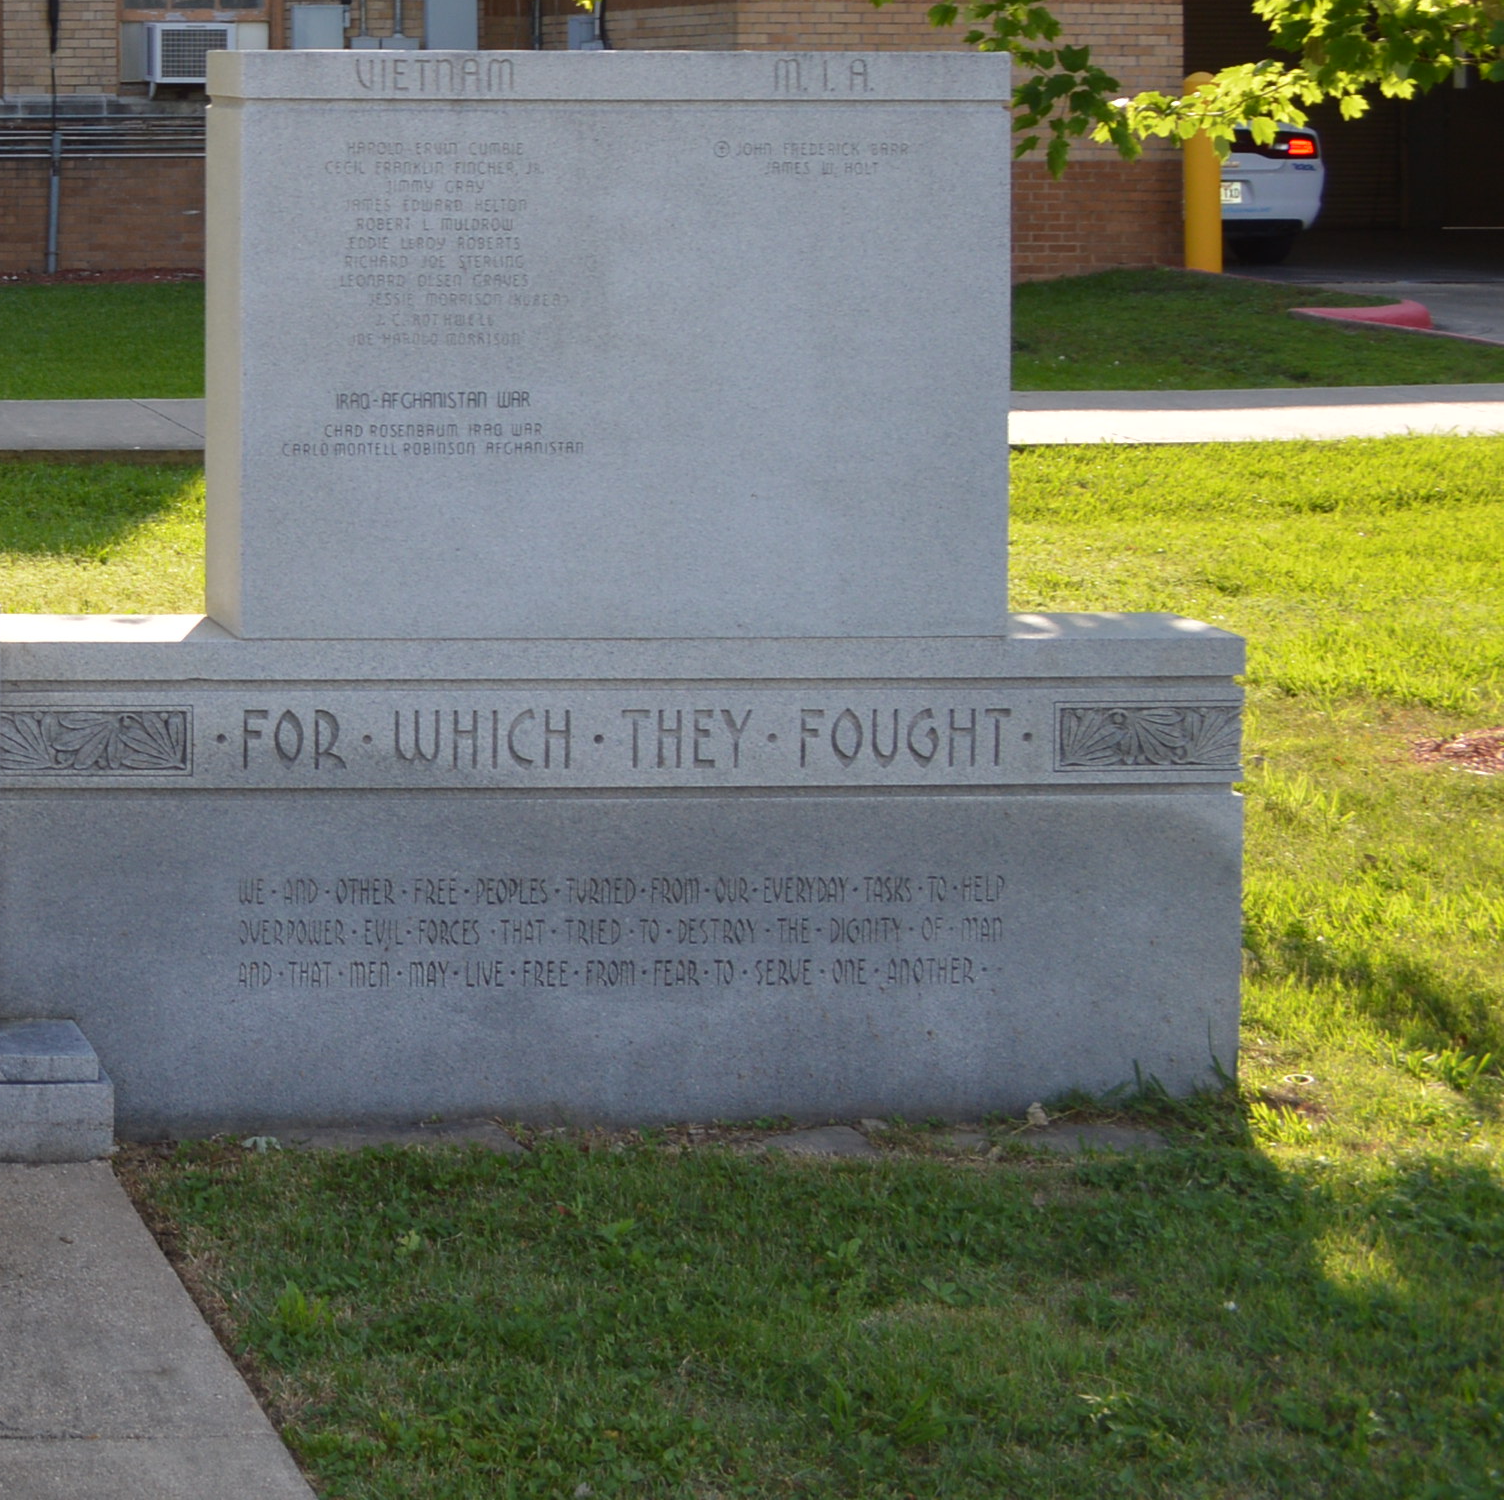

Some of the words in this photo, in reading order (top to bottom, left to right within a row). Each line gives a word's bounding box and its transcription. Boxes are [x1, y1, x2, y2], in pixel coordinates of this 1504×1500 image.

[356, 58, 515, 92] VIETNAM
[356, 218, 410, 231] ROBERT
[442, 218, 514, 231] MULDROW
[498, 391, 531, 408] WAR
[325, 424, 364, 438] CHAD
[371, 424, 458, 438] ROSENBAUM
[468, 423, 503, 437] IRAQ
[512, 423, 543, 437] WAR
[282, 443, 329, 457] CARLO
[335, 442, 398, 456] MONTELL
[403, 442, 475, 456] ROBINSON
[487, 441, 584, 455] AFGHANISTAN
[243, 708, 347, 770] FOR
[394, 708, 571, 770] WHICH
[621, 708, 753, 769] THEY
[800, 707, 1012, 769] FOUGHT
[238, 877, 264, 904] WE
[283, 878, 319, 904] AND
[335, 878, 394, 905] OTHER
[414, 877, 457, 905] FREE
[476, 877, 548, 905] PEOPLES
[566, 877, 636, 904] TURNED
[652, 877, 700, 904] FROM
[715, 876, 750, 903] OUR
[763, 876, 850, 903] EVERYDAY
[864, 876, 913, 902] TASKS
[927, 876, 948, 902] TO
[962, 875, 1005, 901] HELP
[239, 919, 345, 946] OVERPOWER
[365, 919, 404, 946] EVIL
[418, 919, 481, 946] FORCES
[500, 919, 545, 945] THAT
[565, 919, 621, 945] TRIED
[639, 918, 660, 944] TO
[677, 918, 758, 945] DESTROY
[777, 917, 811, 944] THE
[830, 917, 901, 944] DIGNITY
[921, 916, 944, 942] OF
[961, 916, 1003, 943] MAN
[238, 961, 272, 988] AND
[288, 961, 332, 988] THAT
[349, 961, 390, 988] MEN
[408, 961, 450, 988] MAY
[465, 961, 504, 988] LIVE
[522, 961, 569, 988] FREE
[586, 960, 636, 988] FROM
[652, 959, 698, 987] FEAR
[714, 959, 734, 986] TO
[754, 959, 812, 986] SERVE
[832, 958, 867, 985] ONE
[887, 958, 975, 985] ANOTHER
